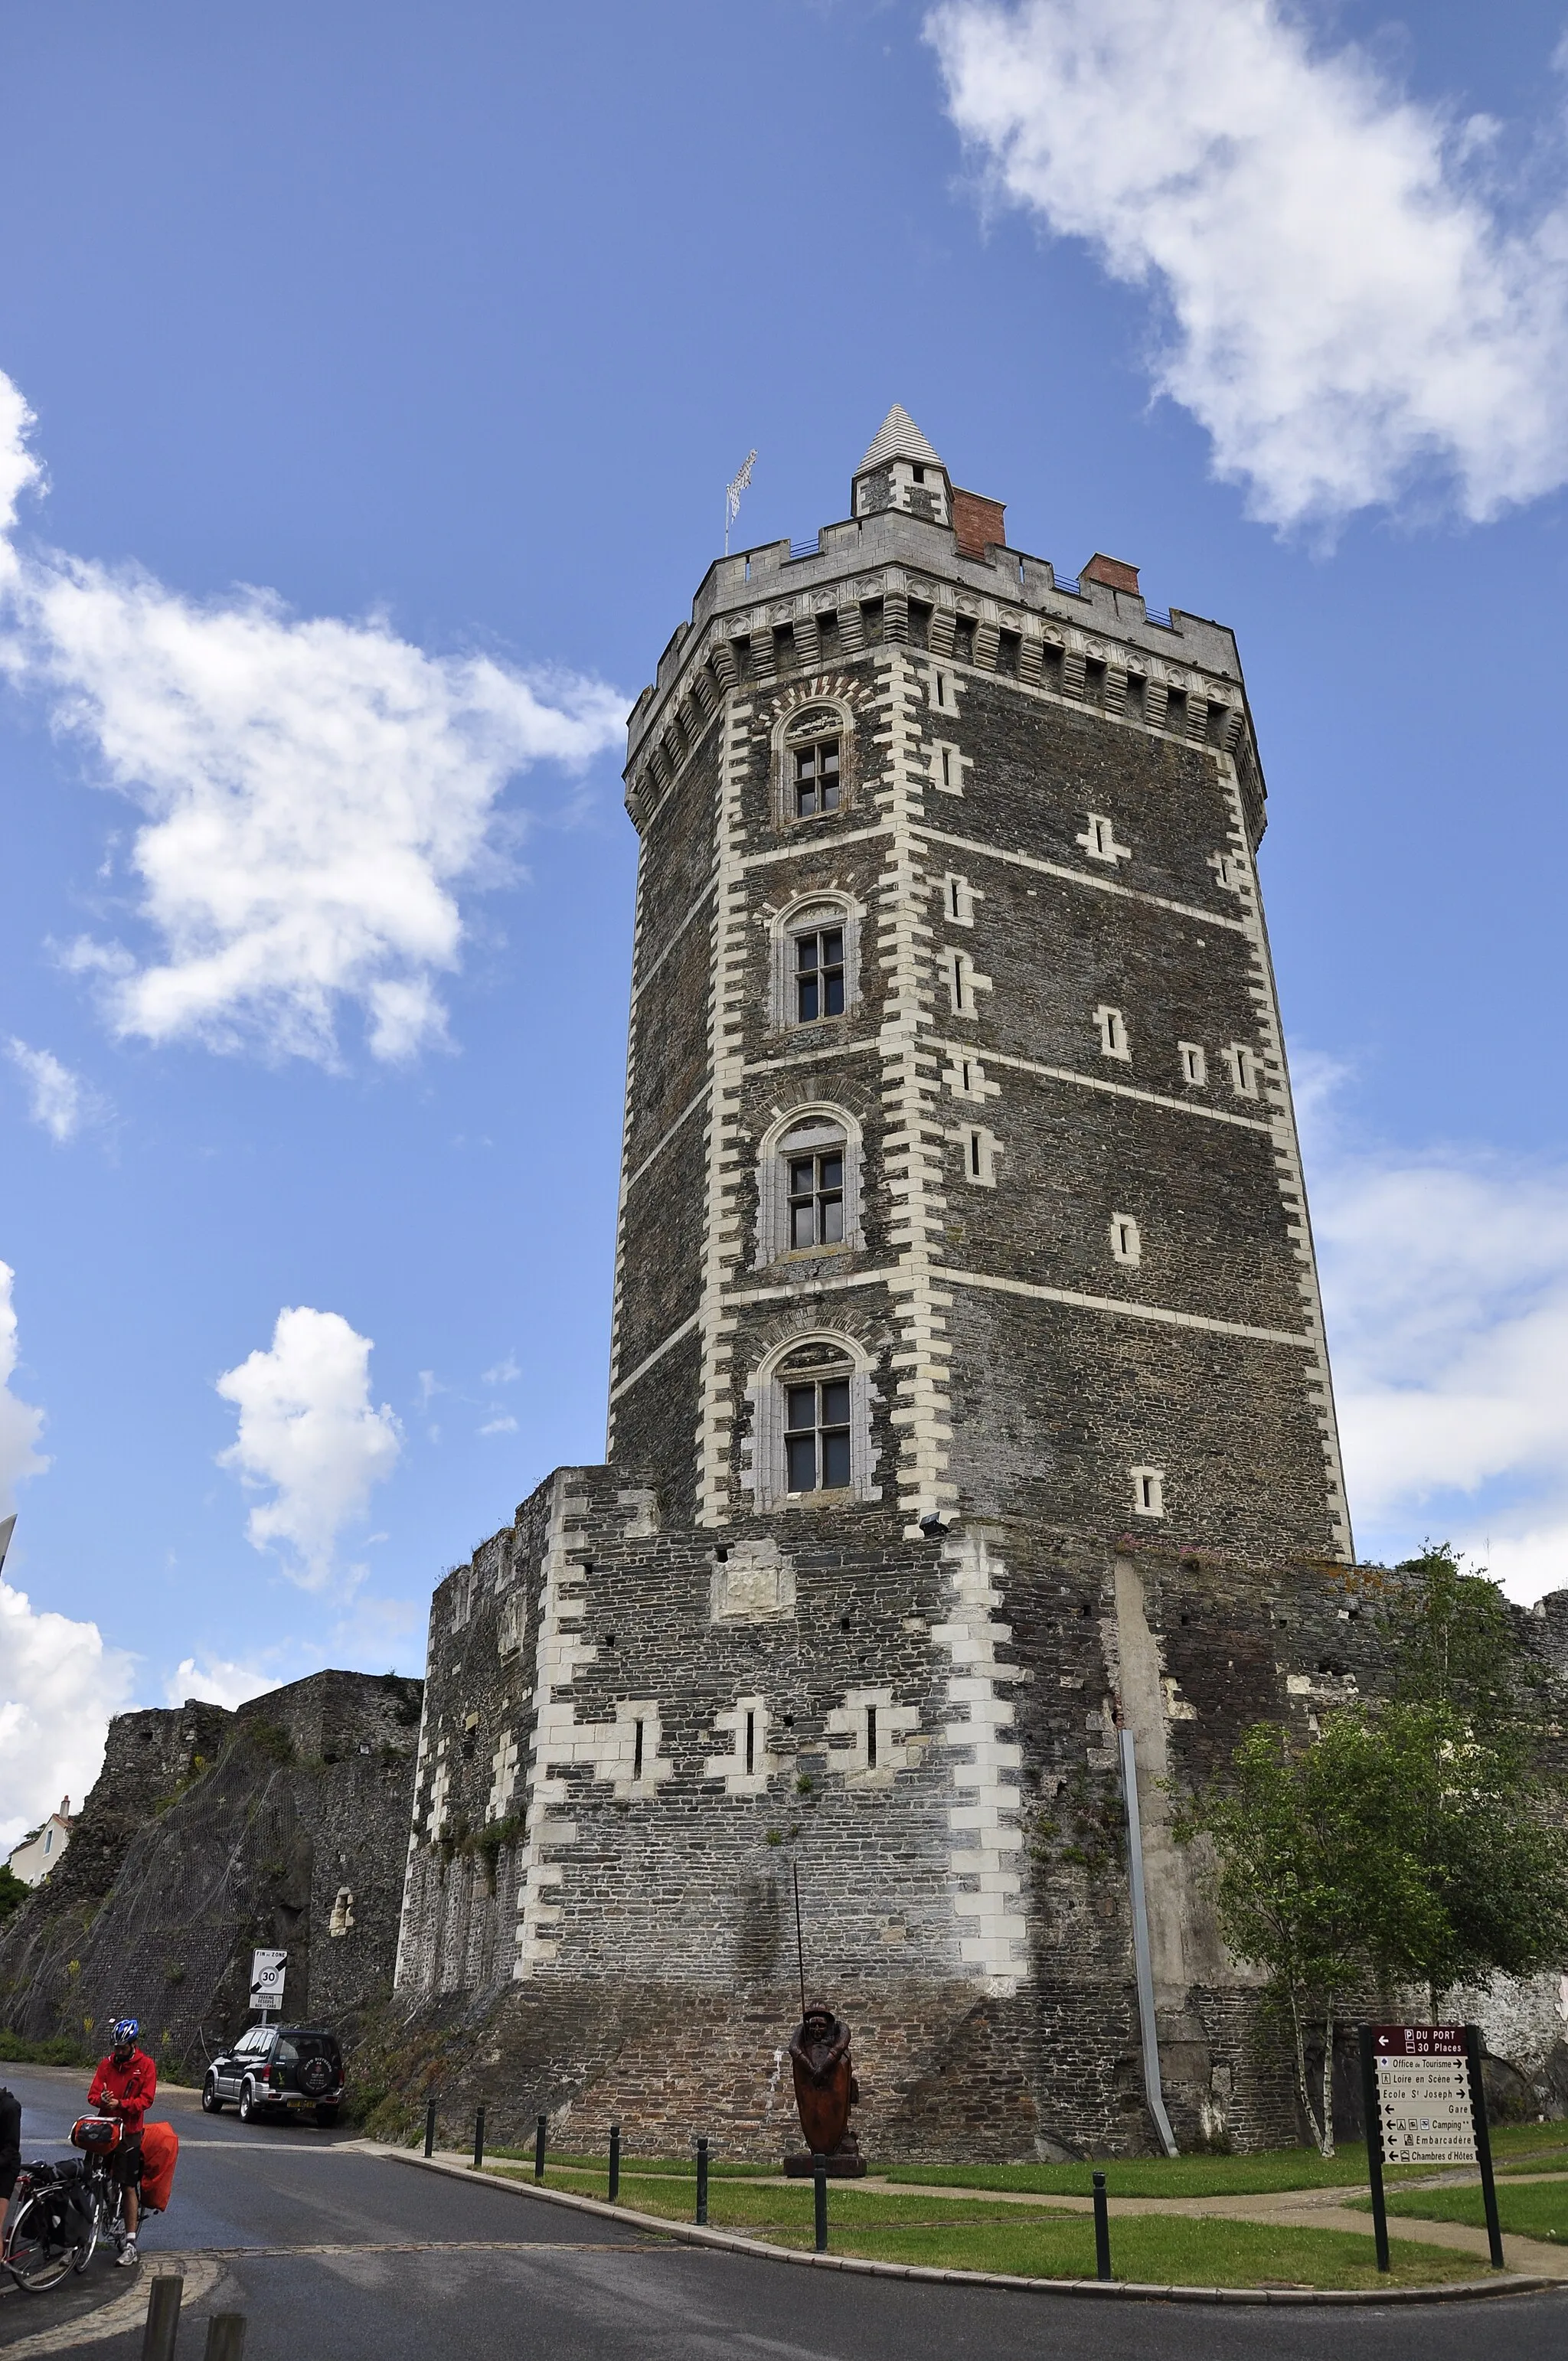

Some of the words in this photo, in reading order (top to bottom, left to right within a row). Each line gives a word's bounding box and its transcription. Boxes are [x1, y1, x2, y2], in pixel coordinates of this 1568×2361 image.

[262, 1972, 275, 1981] 30
[1416, 2030, 1428, 2039] DU
[1433, 2030, 1455, 2039] PORT
[1417, 2043, 1429, 2052] 30
[1434, 2043, 1462, 2052] Places
[1393, 2059, 1413, 2068] Office
[1422, 2059, 1452, 2068] Tourisme
[1393, 2074, 1412, 2083] Loire
[1428, 2074, 1450, 2083] Scène
[1383, 2089, 1406, 2098] Ecole
[1411, 2089, 1419, 2098] St
[1424, 2089, 1452, 2100] Joseph
[1449, 2105, 1468, 2113] Gare
[1416, 2136, 1472, 2144] Embarcadère
[1412, 2151, 1446, 2160] Chambres
